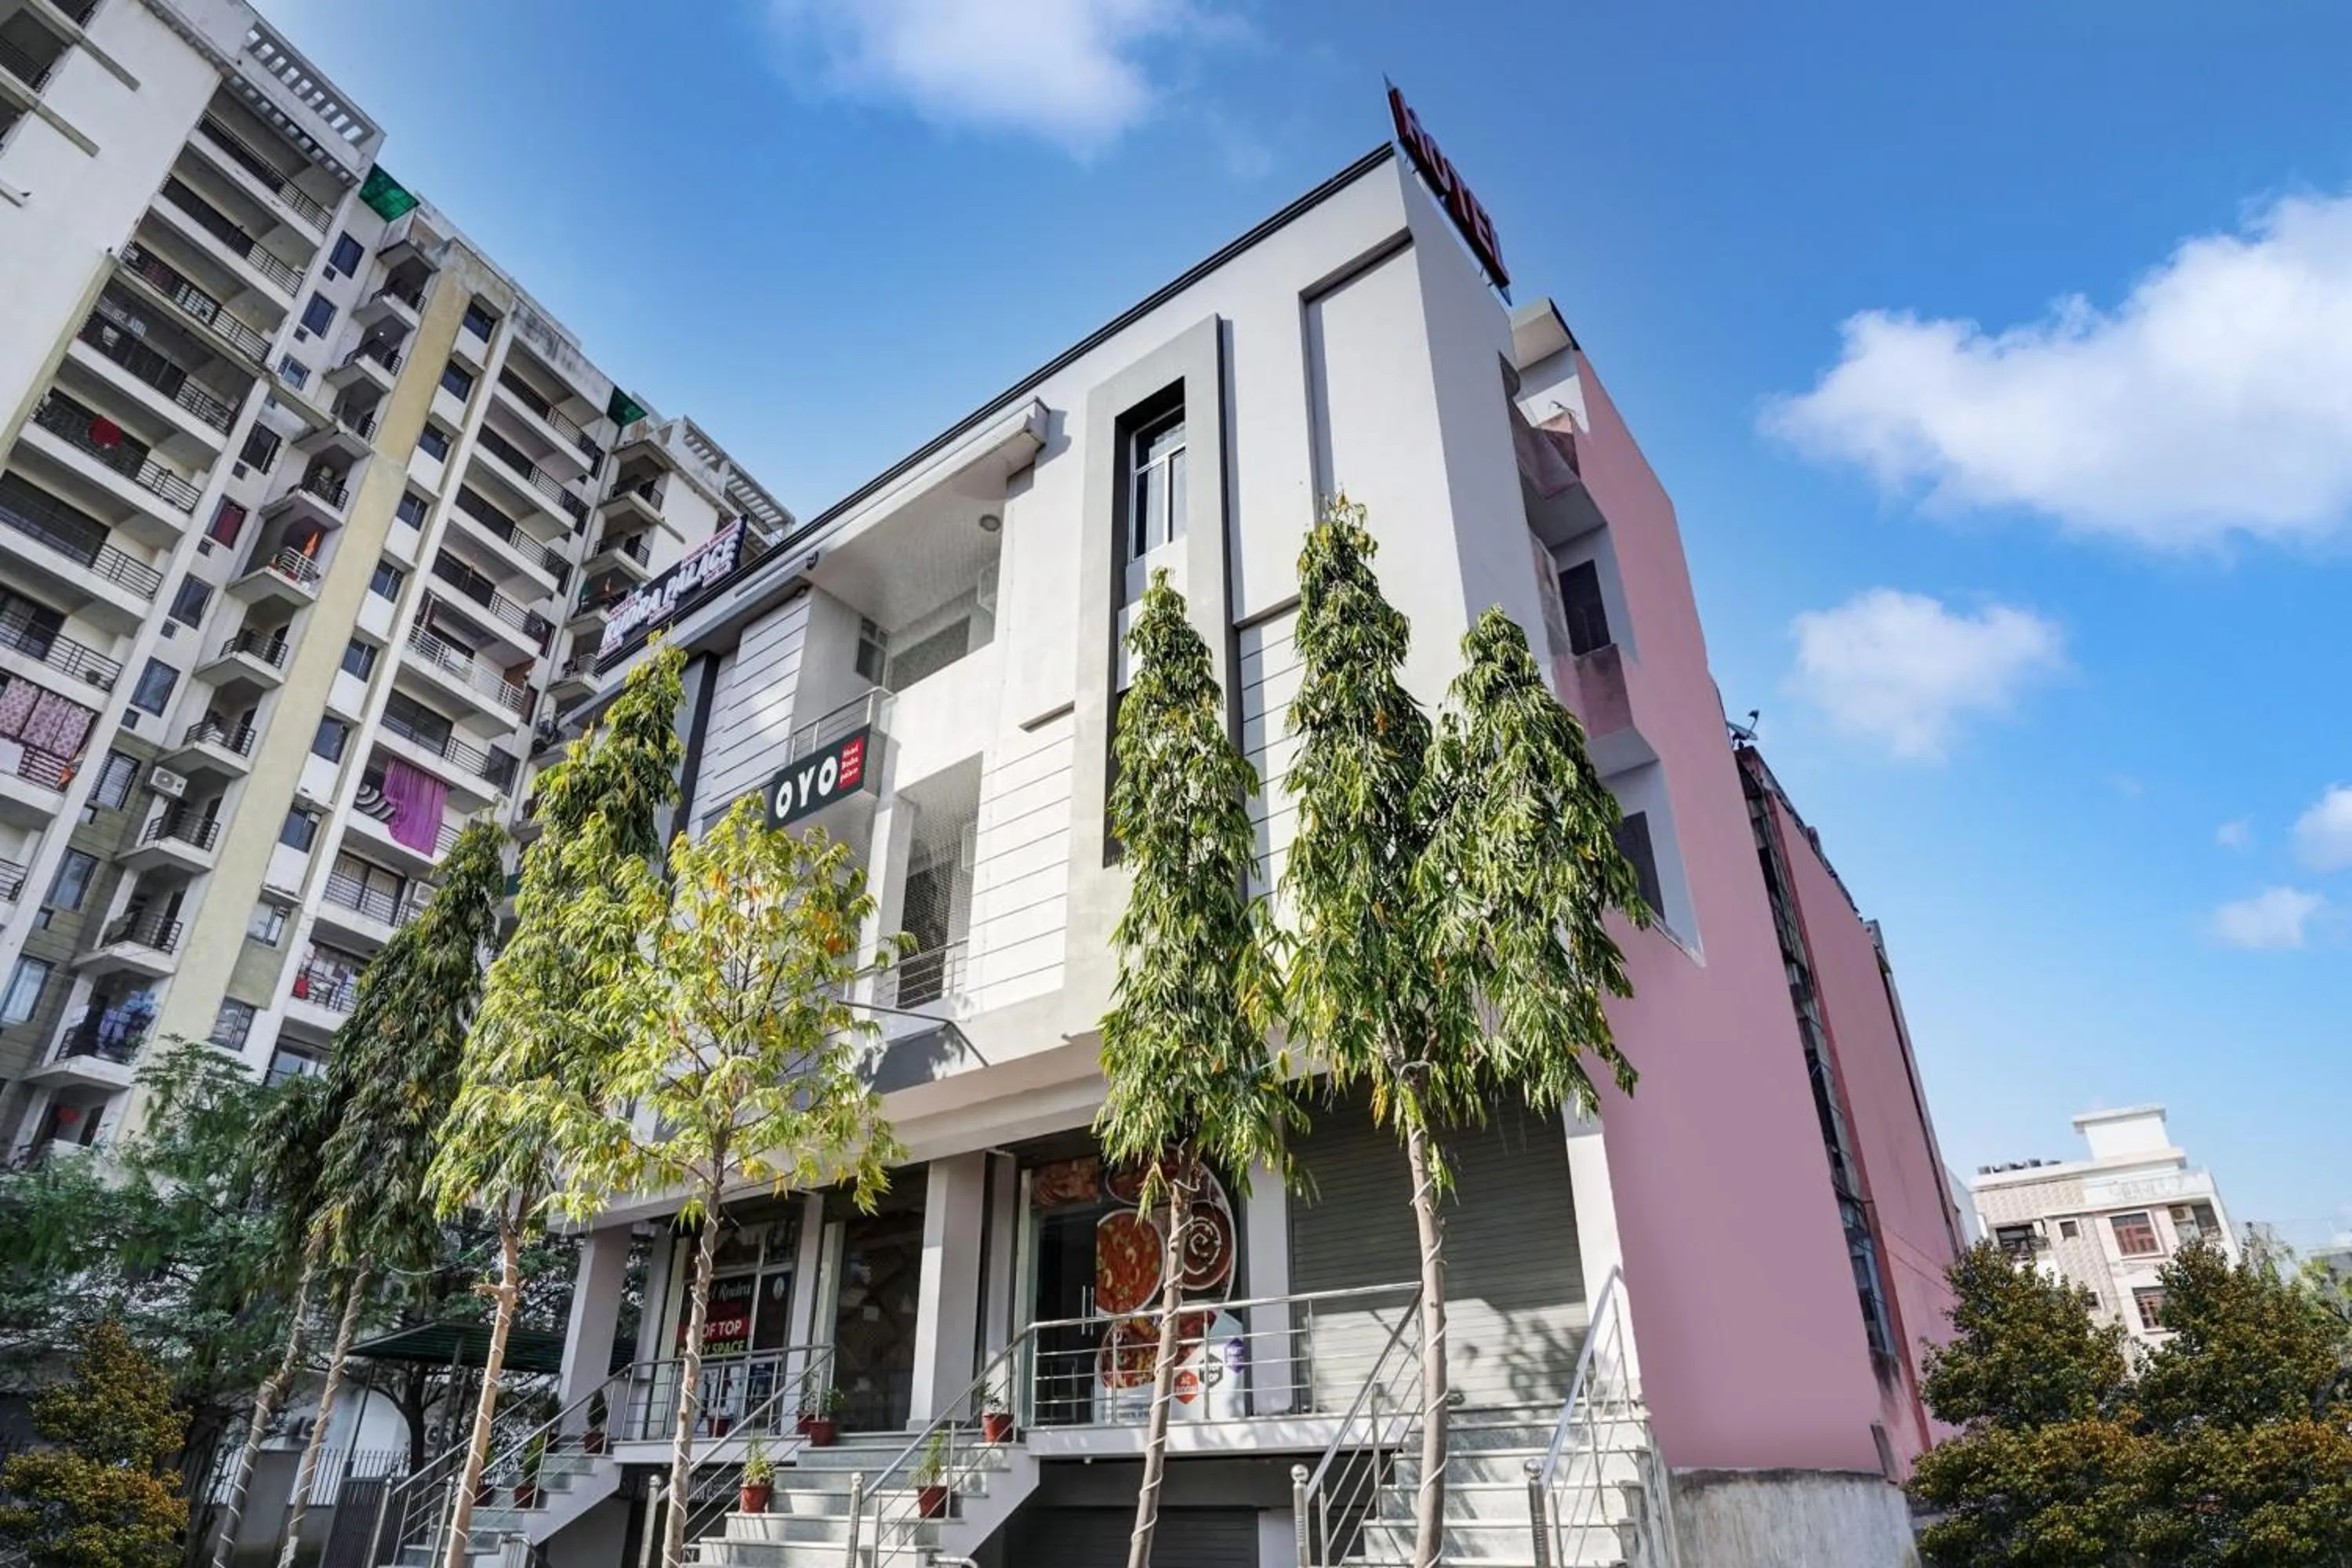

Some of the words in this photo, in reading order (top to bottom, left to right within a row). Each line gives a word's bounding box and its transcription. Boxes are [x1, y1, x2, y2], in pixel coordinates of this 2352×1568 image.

[662, 533, 739, 606] PALACE
[775, 756, 838, 818] OYO
[712, 1339, 745, 1355] SPACE
[718, 1319, 742, 1336] TOP
